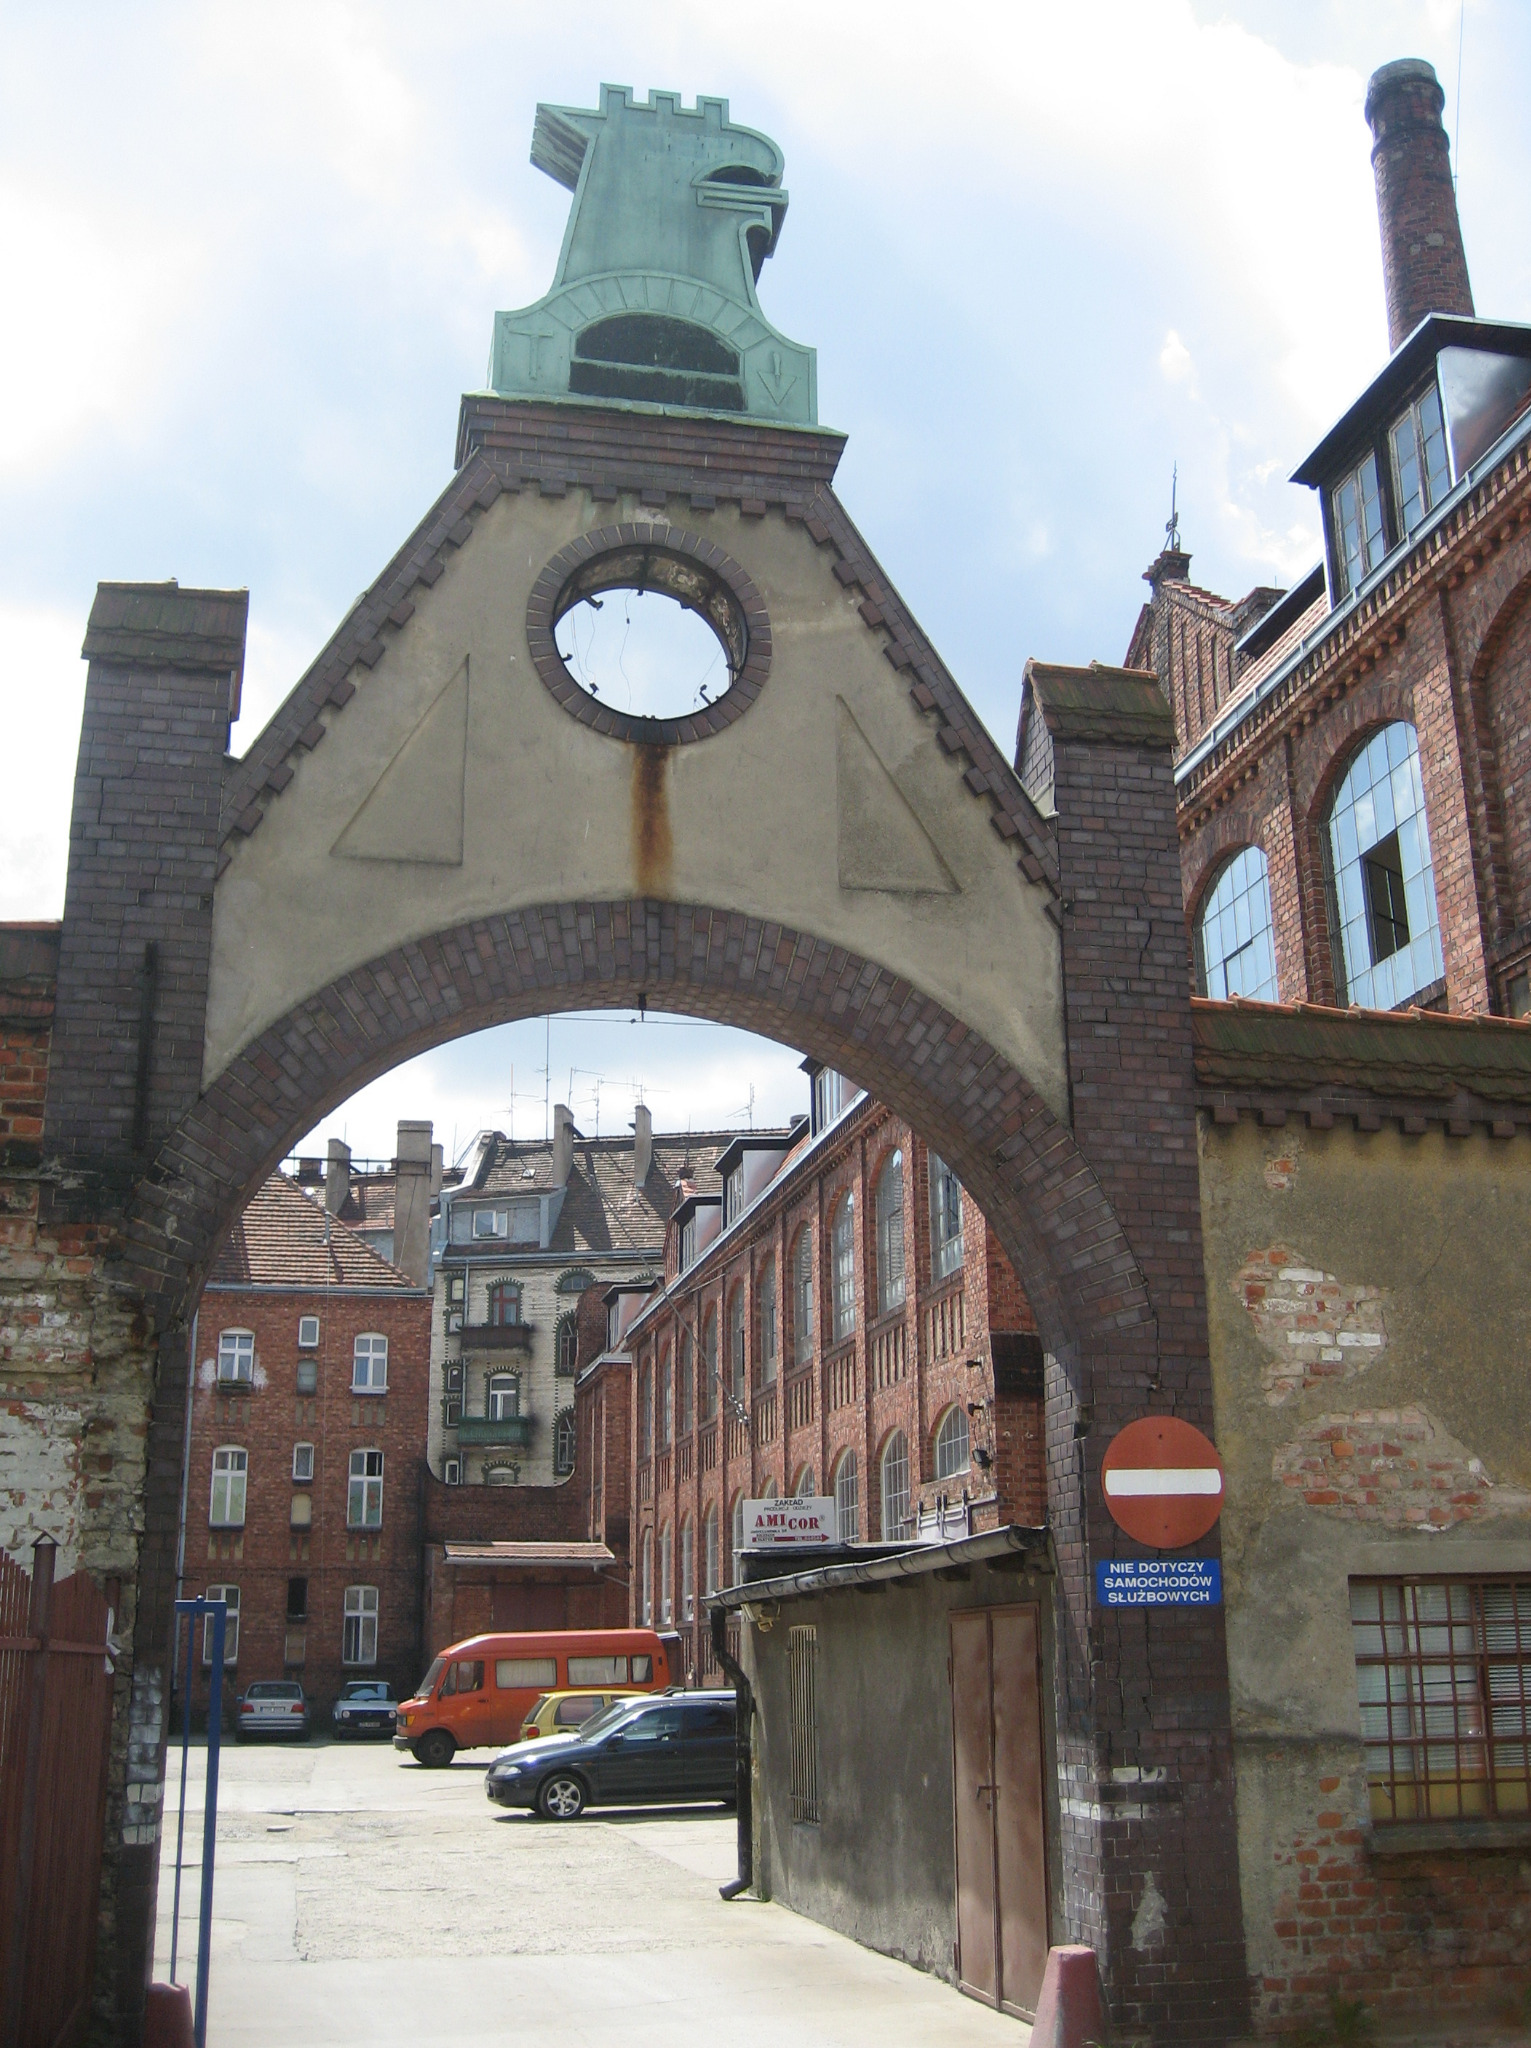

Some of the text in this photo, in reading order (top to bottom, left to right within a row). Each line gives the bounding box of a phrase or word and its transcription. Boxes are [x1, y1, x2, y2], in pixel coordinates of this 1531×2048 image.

[774, 1499, 804, 1507] ZAKŁAD
[1109, 1561, 1205, 1574] NIE DOTYCZY
[1104, 1573, 1213, 1589] SAMOCHODÓW
[1108, 1589, 1210, 1604] SŁUŻBOWYCH
